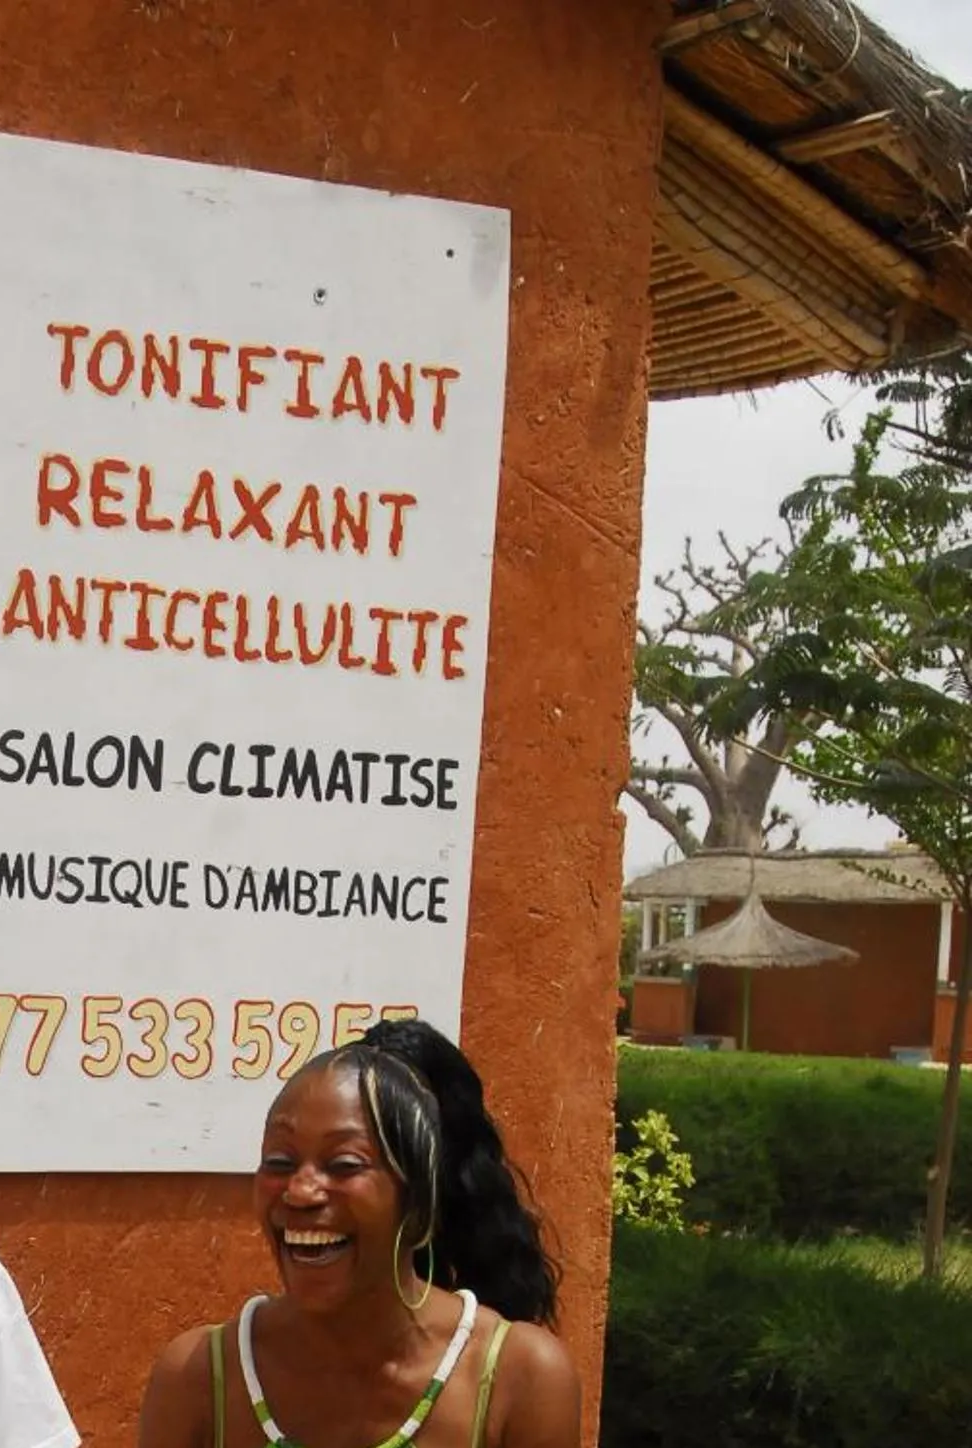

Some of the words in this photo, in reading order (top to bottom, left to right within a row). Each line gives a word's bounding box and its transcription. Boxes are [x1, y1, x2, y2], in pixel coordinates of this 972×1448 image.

[47, 323, 460, 431] TONIFIANT
[37, 453, 417, 556] RELAXANT
[2, 568, 468, 680] ANTICELLULITE
[187, 742, 460, 810] CLIMATISE
[204, 863, 449, 923] D'AMBIANCE
[81, 995, 214, 1079] 533
[232, 1000, 320, 1080] 59
